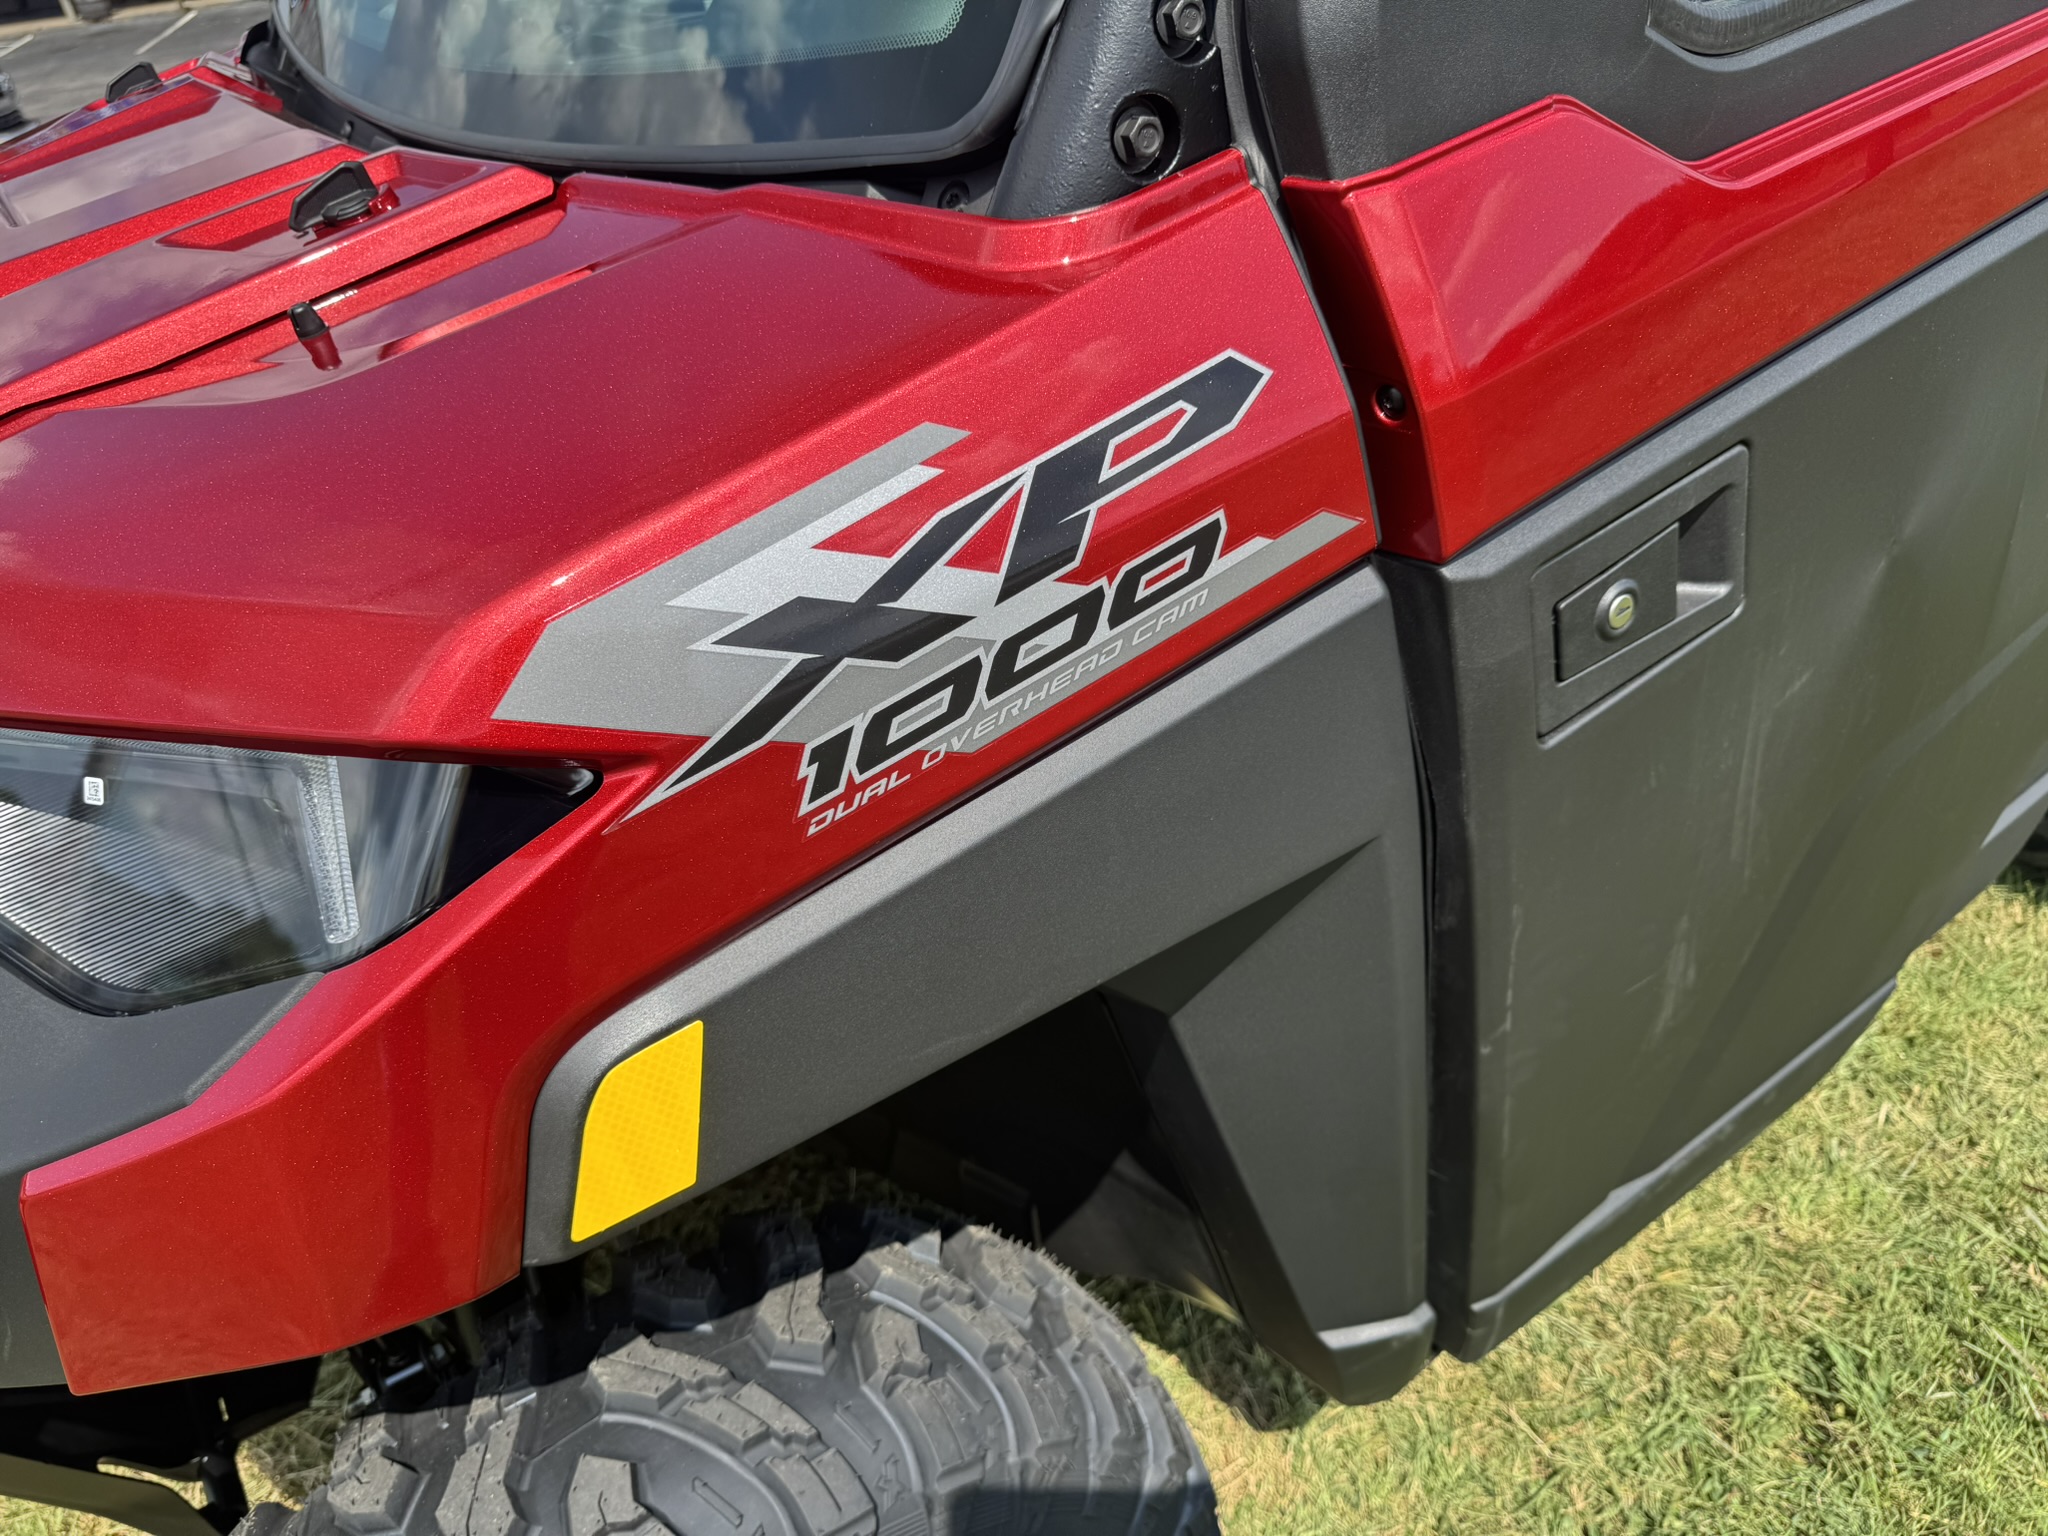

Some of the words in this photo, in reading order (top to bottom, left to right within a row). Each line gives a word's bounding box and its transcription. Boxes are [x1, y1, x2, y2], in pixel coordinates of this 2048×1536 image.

[610, 348, 1273, 830] XP
[797, 508, 1228, 818] 1000
[806, 769, 912, 838] DUAL
[920, 638, 1124, 771] OVERHEAD
[1131, 587, 1210, 647] CAM
